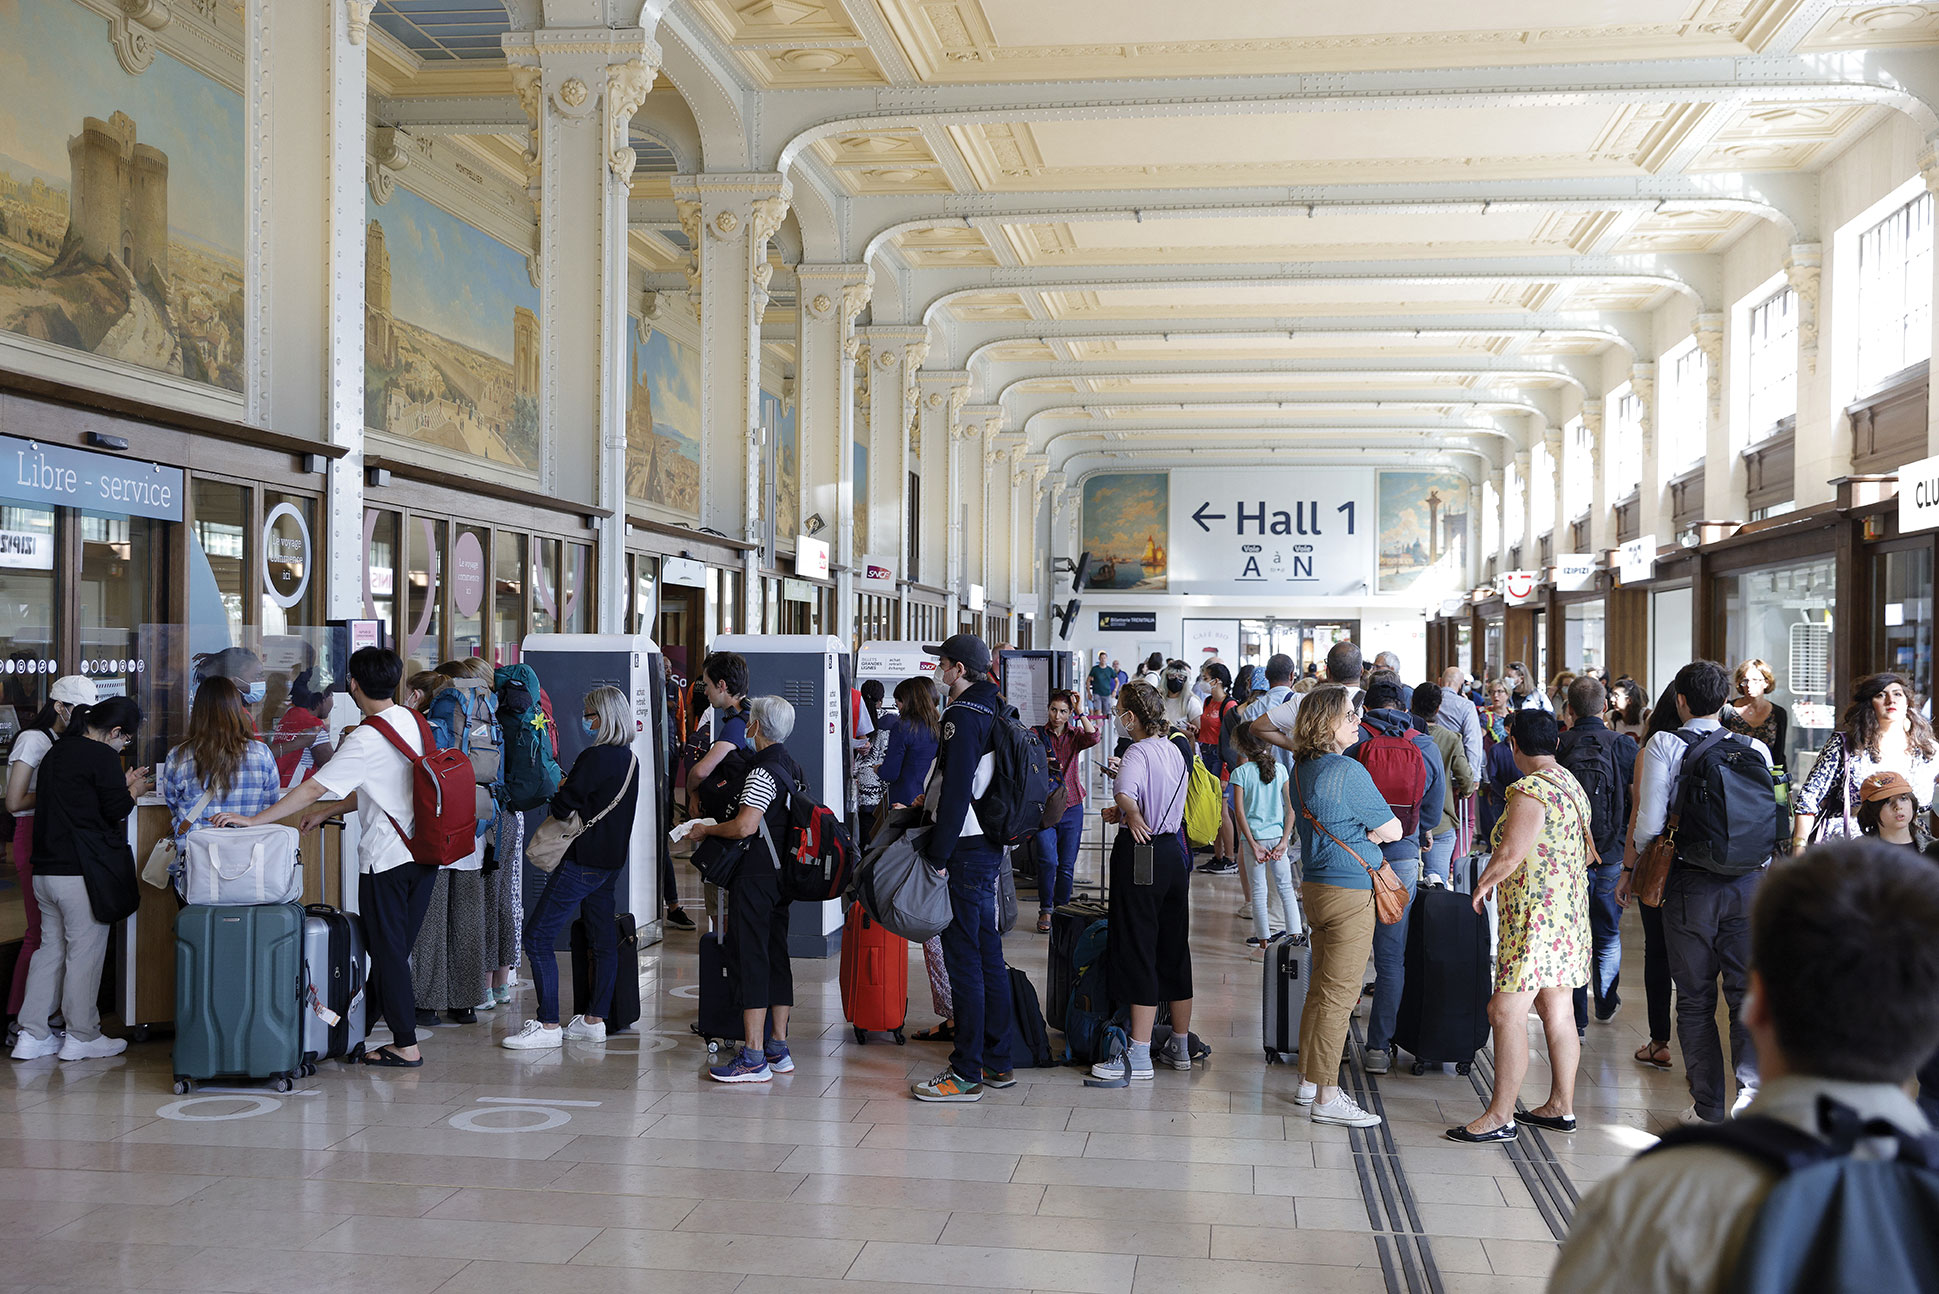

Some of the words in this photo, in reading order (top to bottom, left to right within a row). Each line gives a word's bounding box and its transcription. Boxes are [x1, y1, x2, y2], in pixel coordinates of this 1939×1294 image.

[17, 451, 77, 493] Libre
[100, 476, 171, 508] service
[1237, 501, 1322, 535] Hall
[1337, 501, 1354, 535] 1
[281, 537, 302, 550] voyage
[1242, 556, 1261, 577] A
[1273, 551, 1281, 564] à
[1294, 556, 1312, 577] N
[282, 569, 291, 580] ici
[867, 569, 891, 580] SNCF
